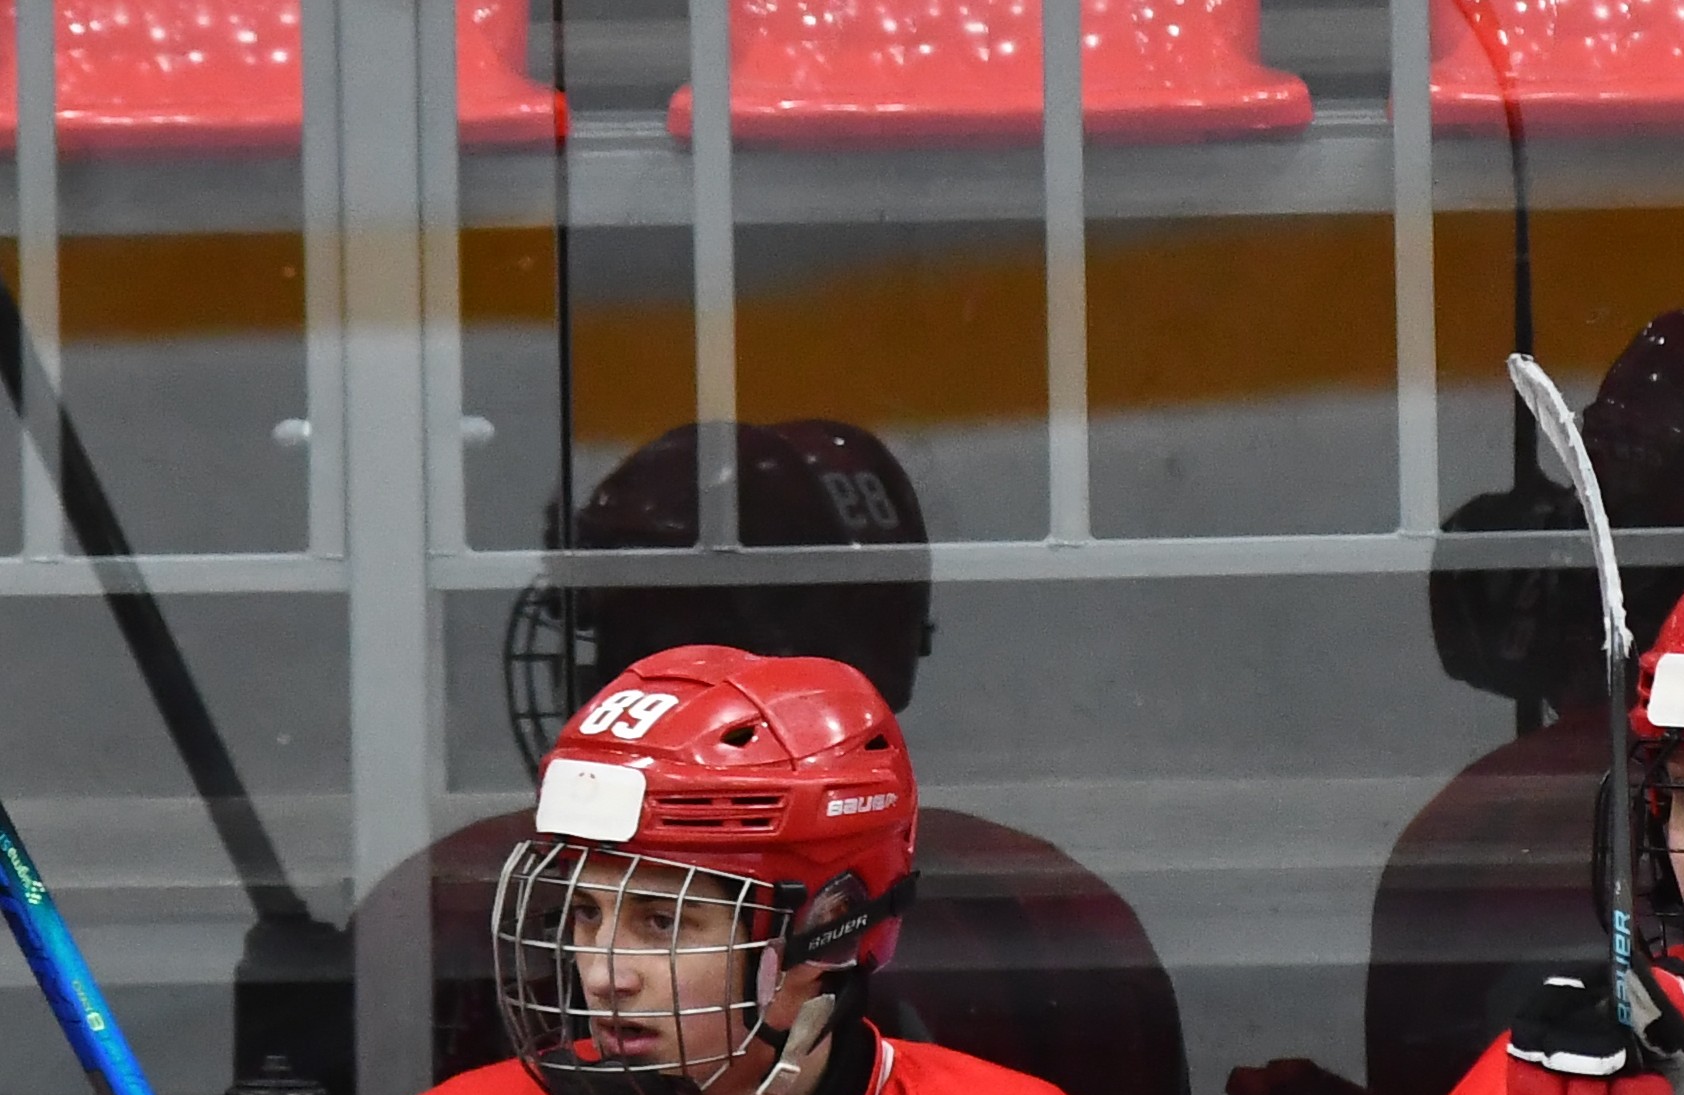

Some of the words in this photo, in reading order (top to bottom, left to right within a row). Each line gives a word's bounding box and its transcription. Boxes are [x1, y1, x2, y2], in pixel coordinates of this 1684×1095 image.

[579, 689, 680, 740] 89
[826, 793, 898, 817] BAUER
[808, 913, 869, 951] BAUER
